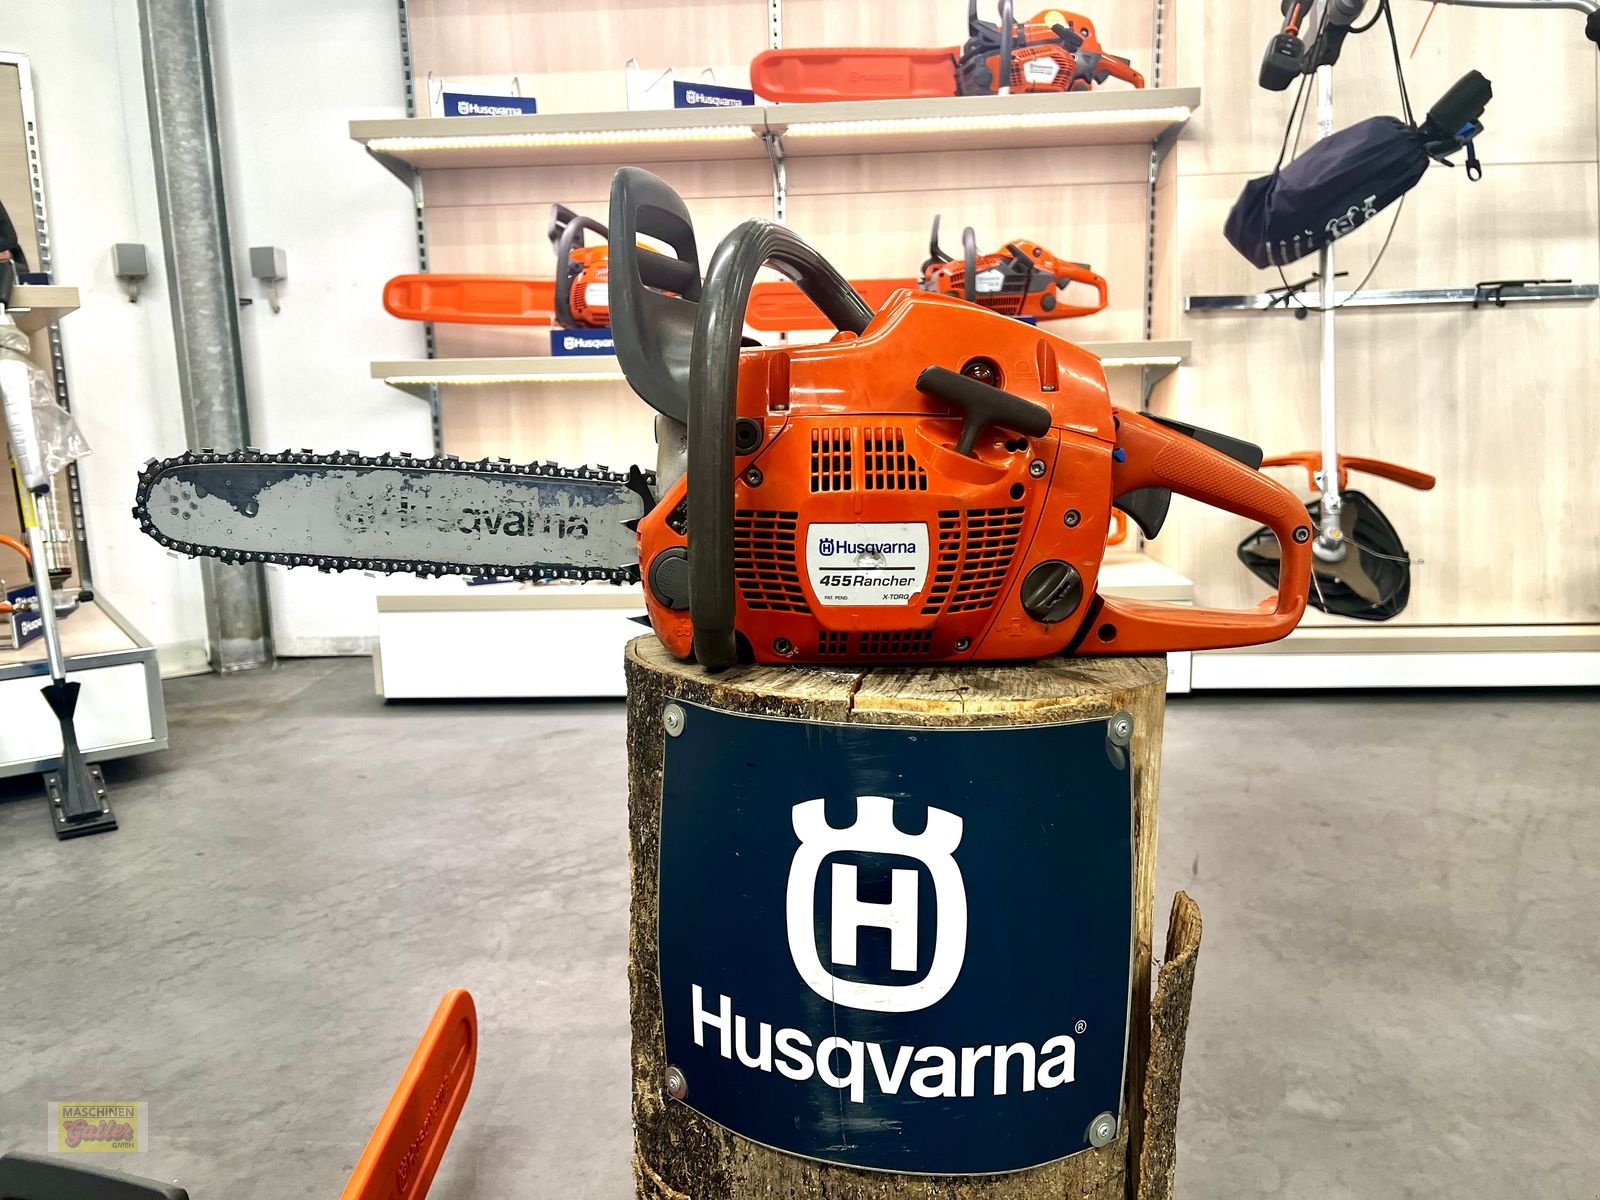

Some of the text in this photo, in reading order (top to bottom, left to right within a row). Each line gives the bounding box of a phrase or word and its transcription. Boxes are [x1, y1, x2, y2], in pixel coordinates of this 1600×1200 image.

[469, 103, 523, 116] Husqvarna
[836, 540, 916, 555] Husqvarna
[819, 575, 916, 587] 455 Rancher
[691, 983, 1077, 1104] Husqvarna
